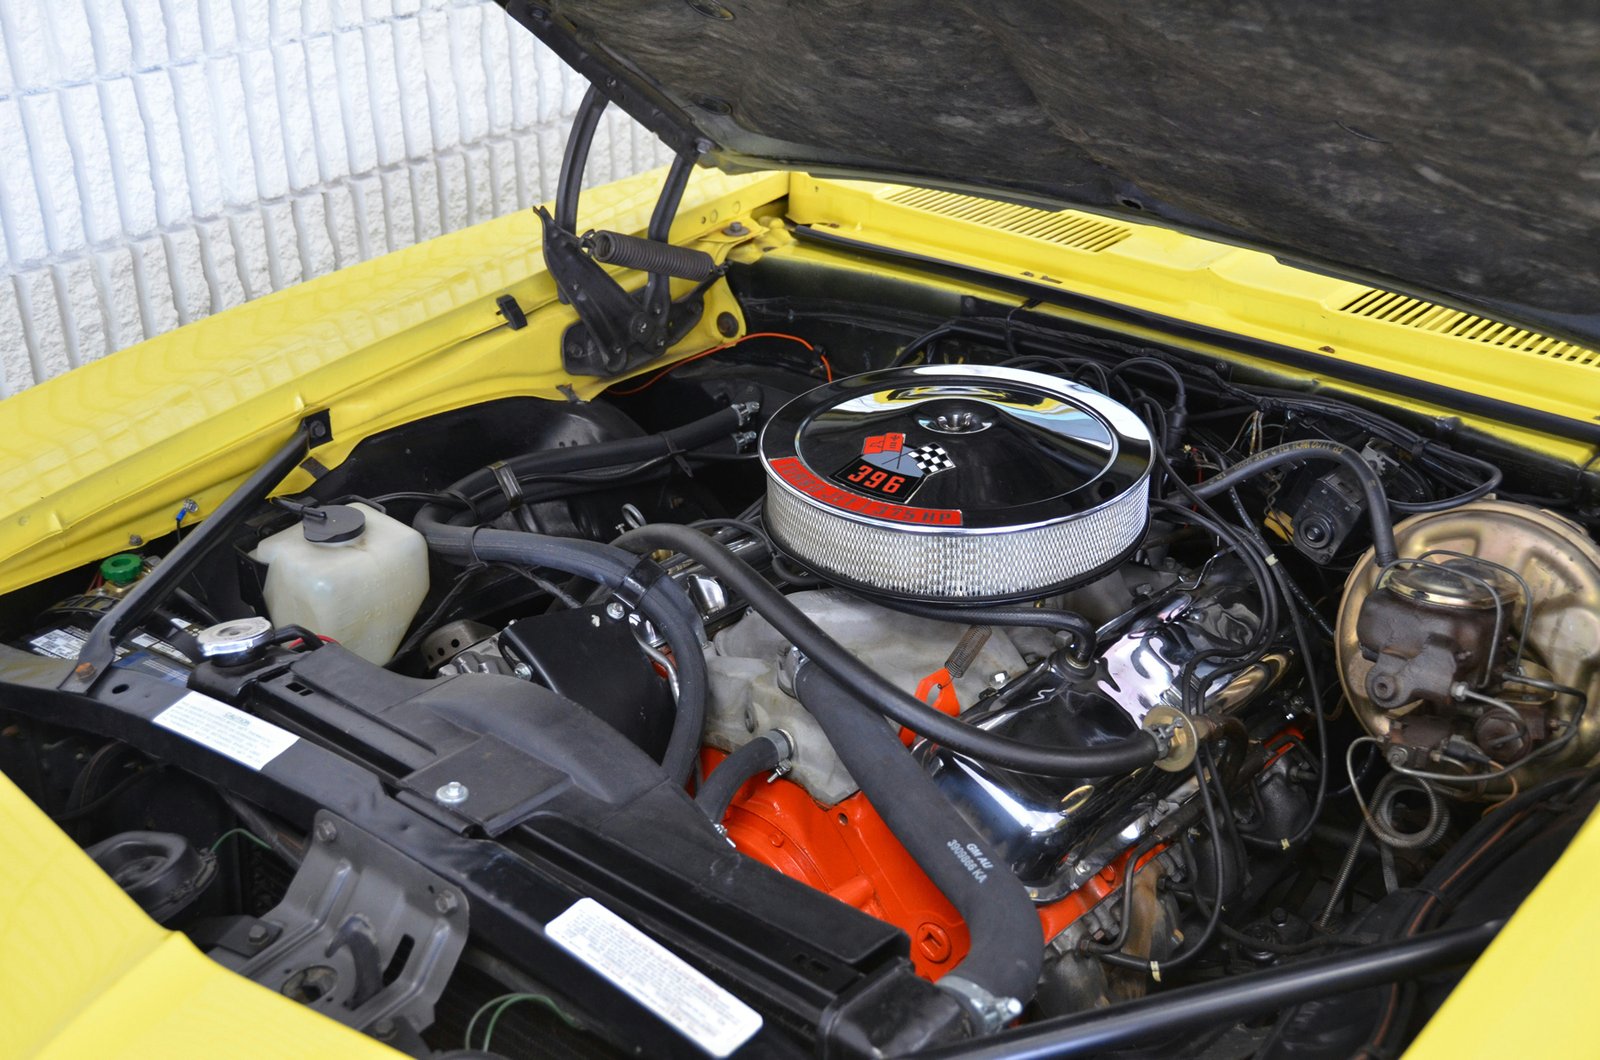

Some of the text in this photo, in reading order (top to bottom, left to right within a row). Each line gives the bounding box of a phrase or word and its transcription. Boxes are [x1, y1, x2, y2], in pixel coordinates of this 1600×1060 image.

[847, 465, 906, 494] 396
[872, 504, 916, 521] 375
[922, 512, 953, 523] HP
[966, 843, 994, 869] GM AU
[972, 868, 988, 883] KA
